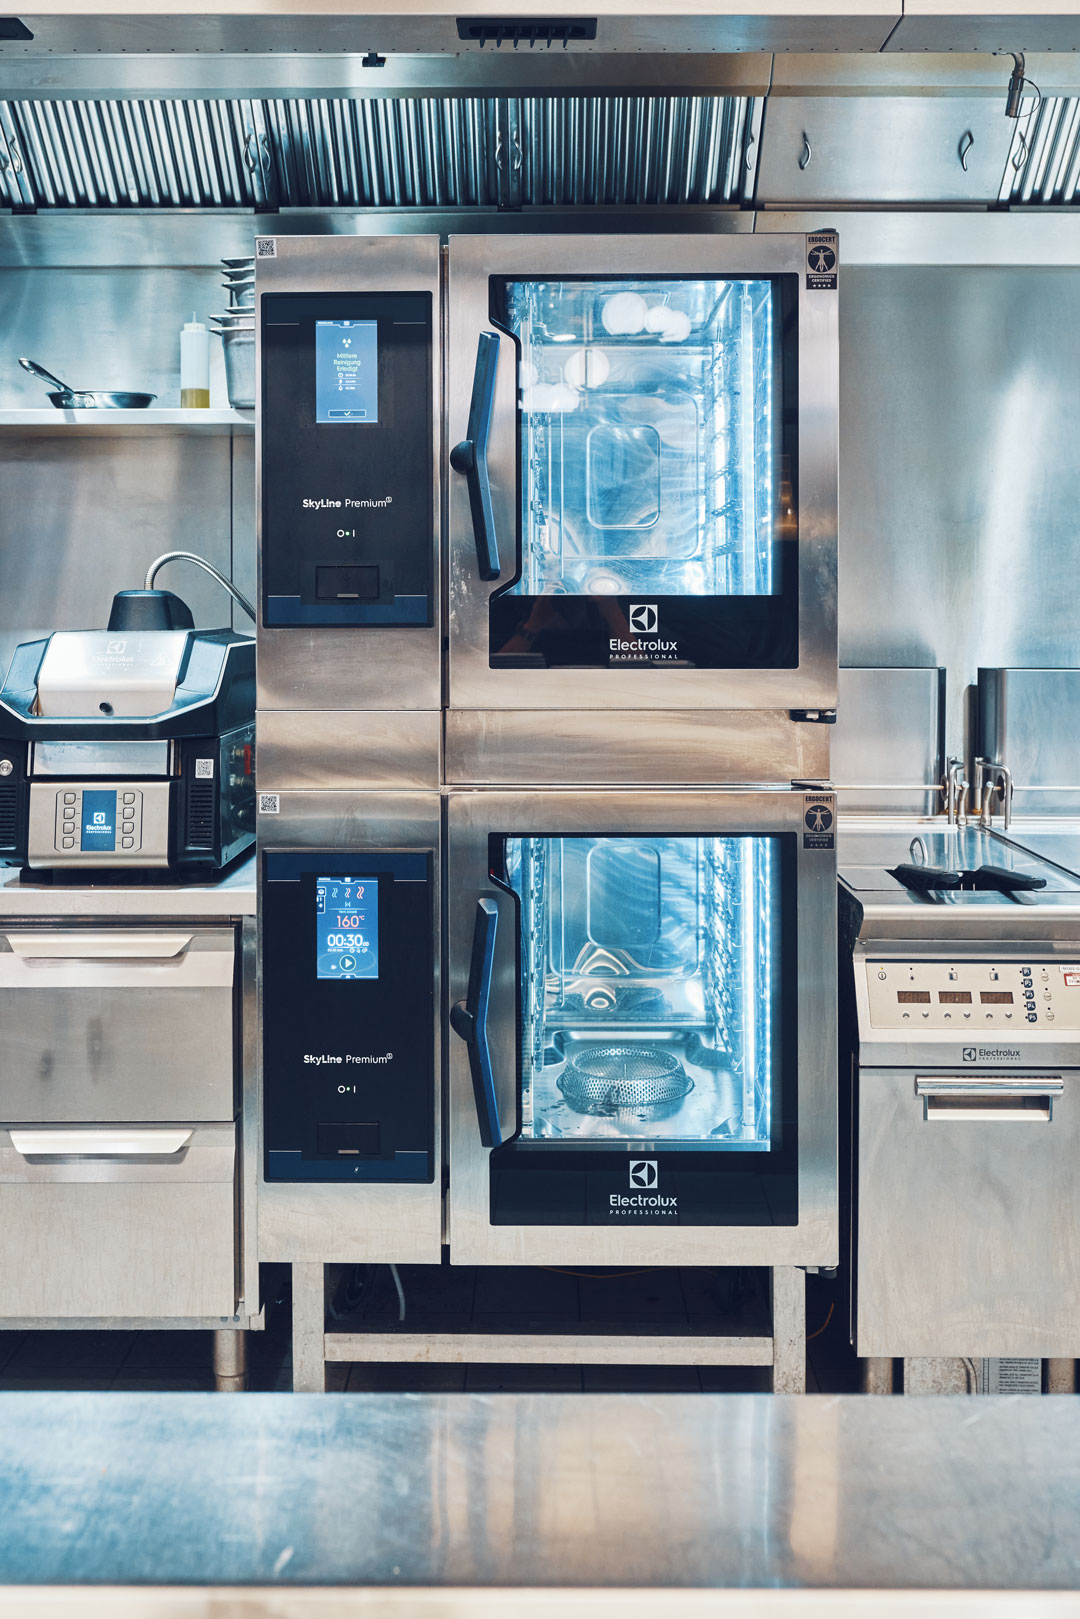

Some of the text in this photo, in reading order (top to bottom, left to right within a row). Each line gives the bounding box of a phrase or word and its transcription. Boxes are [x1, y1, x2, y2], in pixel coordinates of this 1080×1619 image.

[302, 498, 342, 510] SkyLine
[609, 638, 678, 651] Electrolux
[978, 1049, 1021, 1057] Electrolux
[303, 1054, 343, 1066] SkyLine
[609, 1194, 678, 1207] Electrolux
